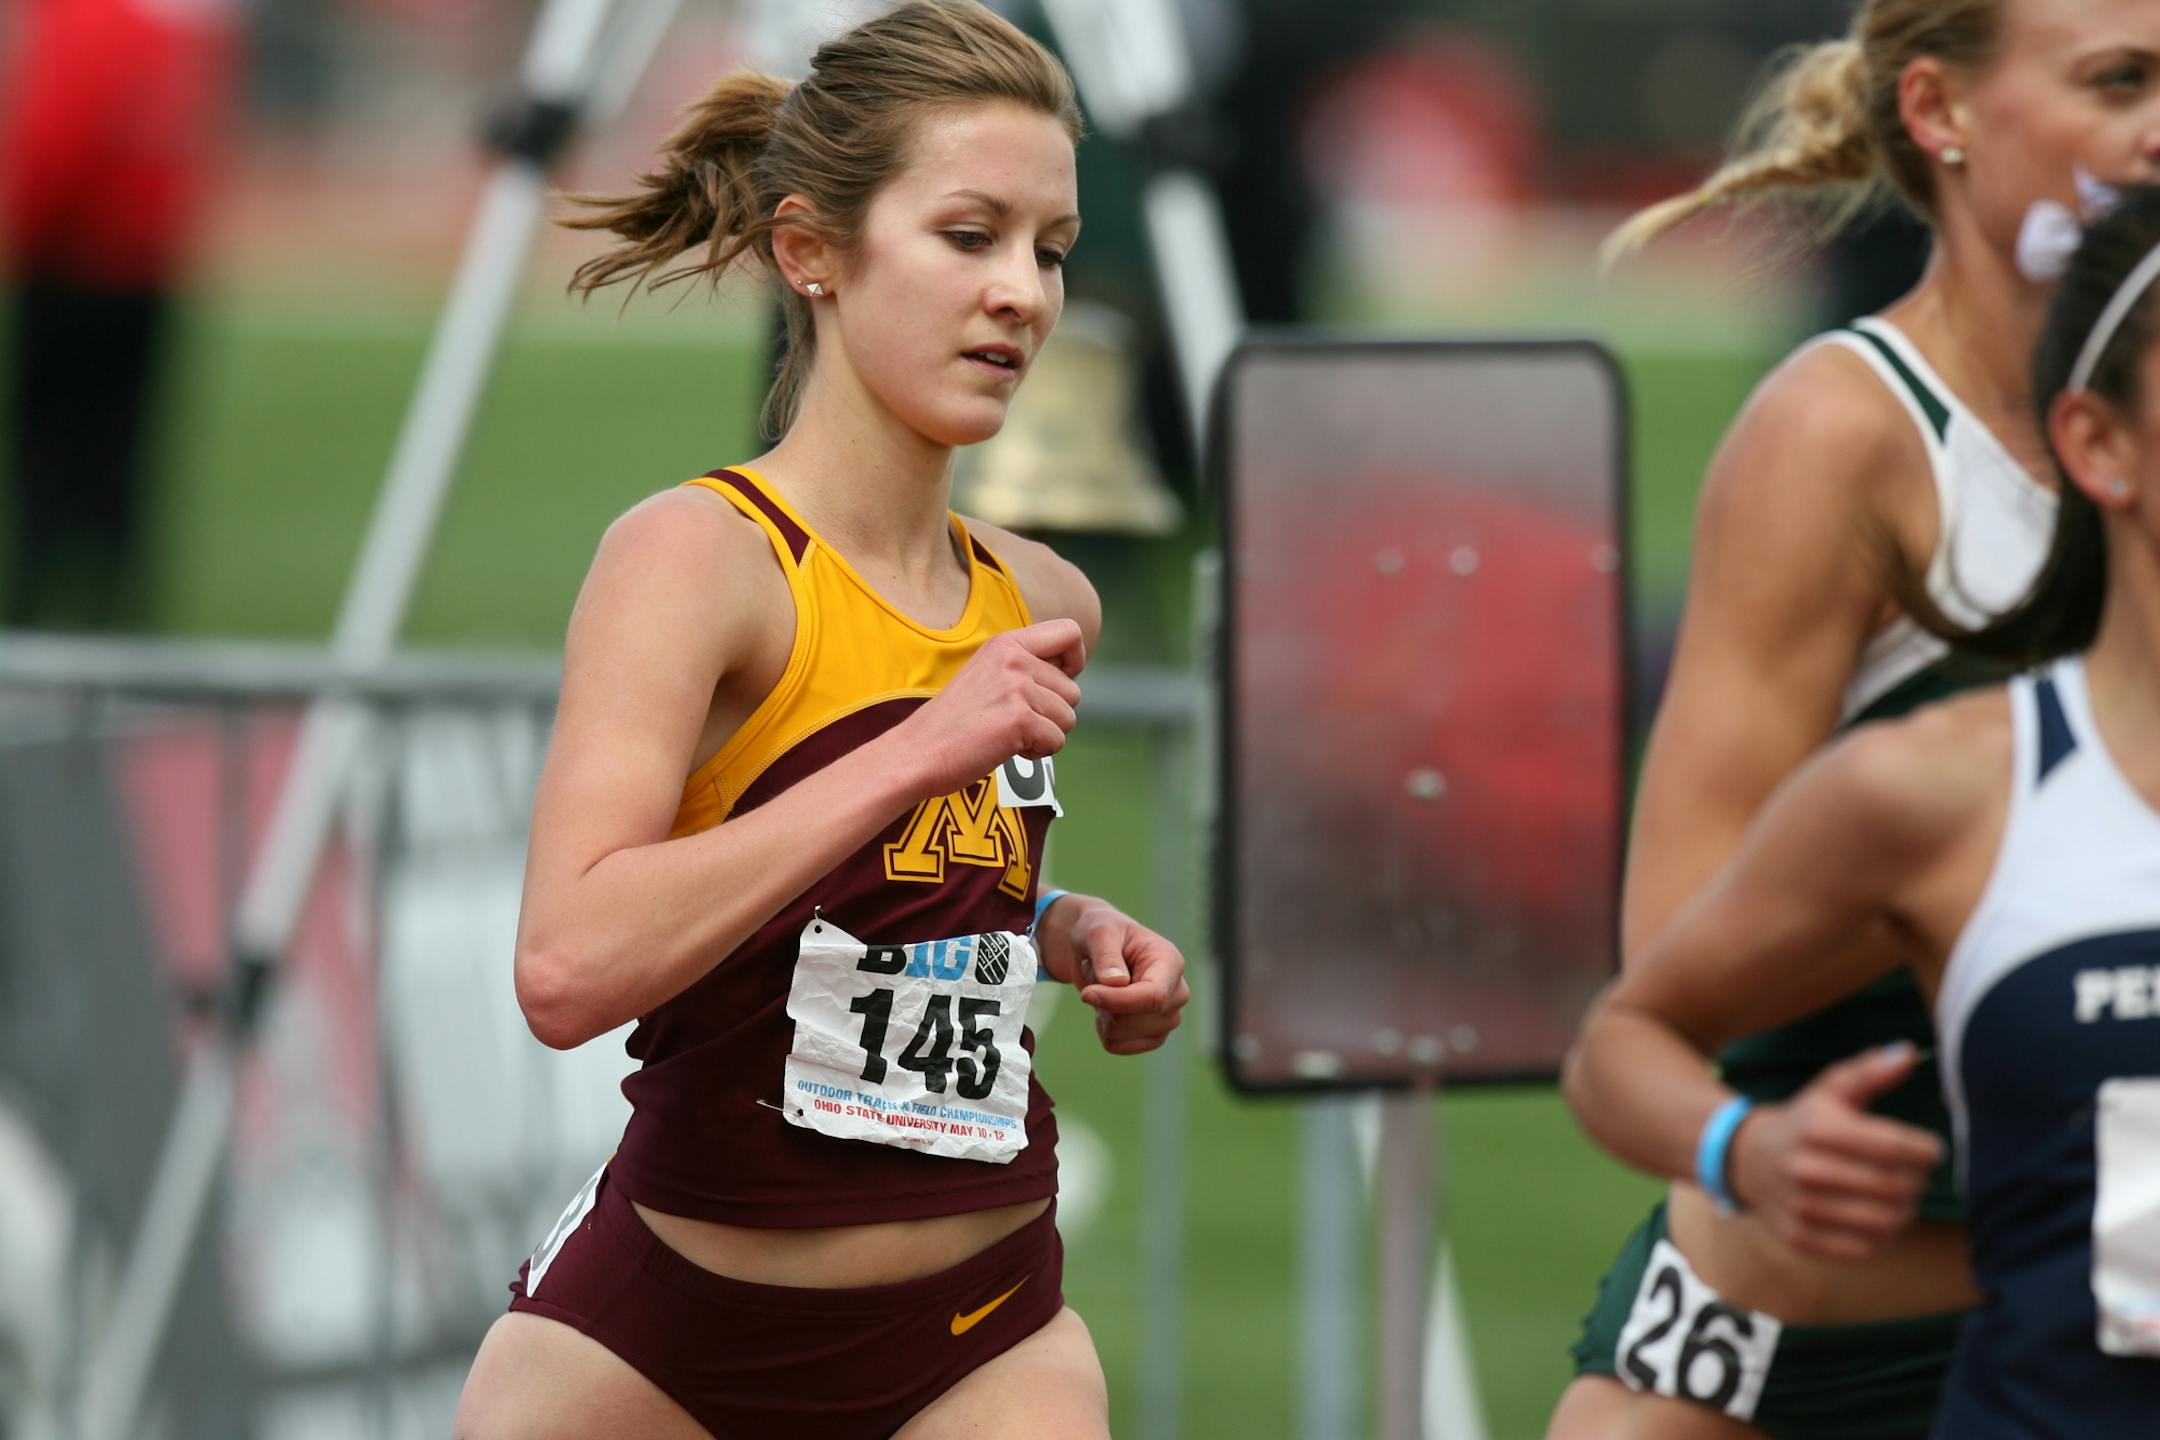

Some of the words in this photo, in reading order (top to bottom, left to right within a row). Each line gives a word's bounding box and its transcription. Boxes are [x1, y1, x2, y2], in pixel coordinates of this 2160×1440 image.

[884, 769, 1031, 902] M
[2072, 965, 2160, 1023] PE
[850, 988, 1001, 1100] 145
[797, 1079, 853, 1101] OUTDOOR
[857, 1092, 898, 1111] TRACK
[901, 1101, 910, 1112] &
[912, 1103, 937, 1117] FIELD
[940, 1105, 1017, 1129] CHAMPIONSHIPS
[814, 1099, 842, 1115] OHIO
[846, 1105, 884, 1122] STATE
[886, 1114, 947, 1133] UNIVERSITY
[950, 1123, 974, 1136] MAY
[1625, 1266, 1754, 1411] 26
